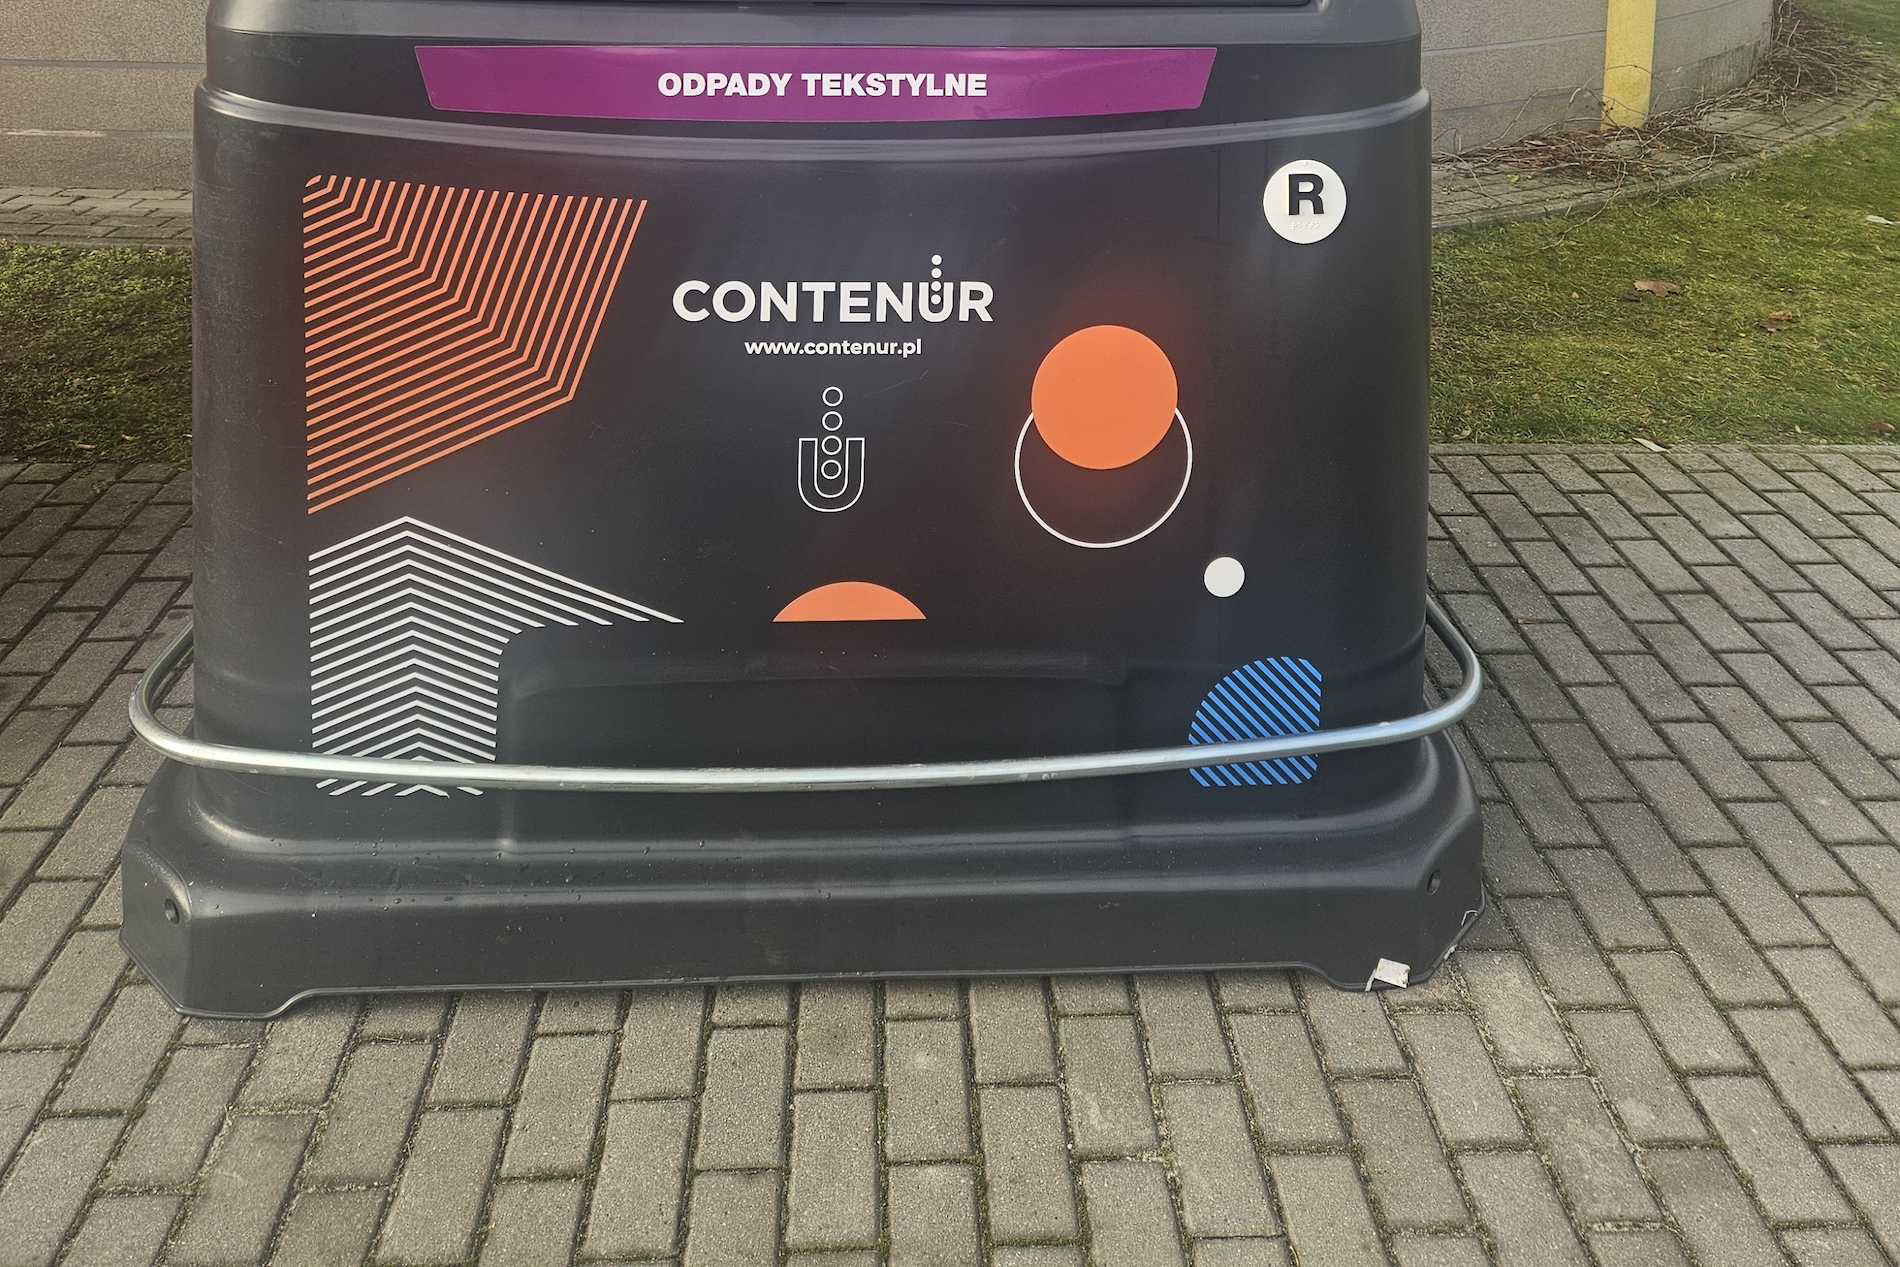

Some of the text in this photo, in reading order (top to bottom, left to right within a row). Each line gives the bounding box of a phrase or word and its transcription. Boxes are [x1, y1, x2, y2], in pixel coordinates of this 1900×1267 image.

[657, 72, 988, 97] ODPADY TEKSTYLNE
[1288, 173, 1324, 216] R
[672, 255, 994, 323] CONTENUR
[744, 338, 922, 359] www.contenur.pl
